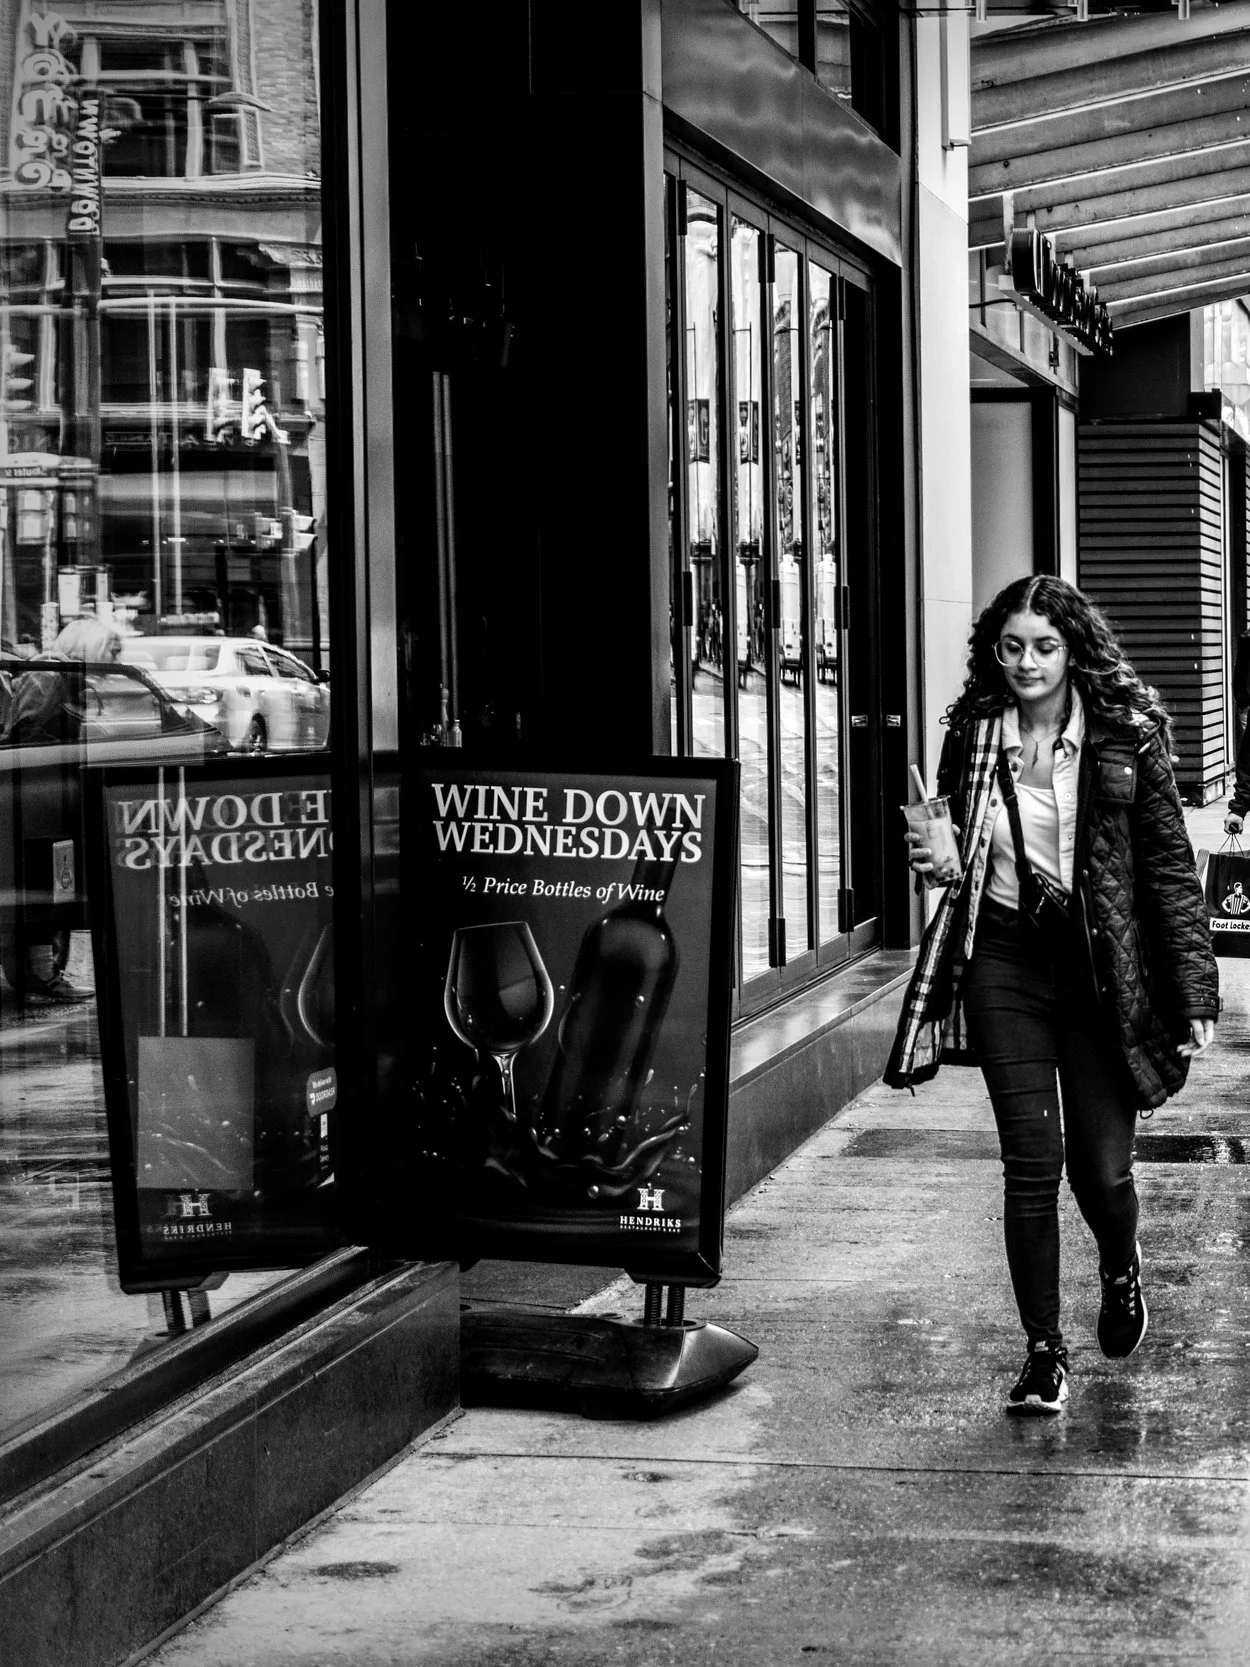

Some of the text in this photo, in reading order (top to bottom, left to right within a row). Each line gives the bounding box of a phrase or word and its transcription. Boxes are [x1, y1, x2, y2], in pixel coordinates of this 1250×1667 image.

[431, 783, 706, 829] WINE DOWN
[432, 820, 703, 864] WEDNESDAYS
[483, 877, 528, 895] Price
[532, 880, 592, 899] Bottles
[596, 882, 618, 904] of
[619, 884, 666, 902] Wine
[1212, 920, 1229, 929] Foot
[620, 1215, 682, 1228] HENDRIKS
